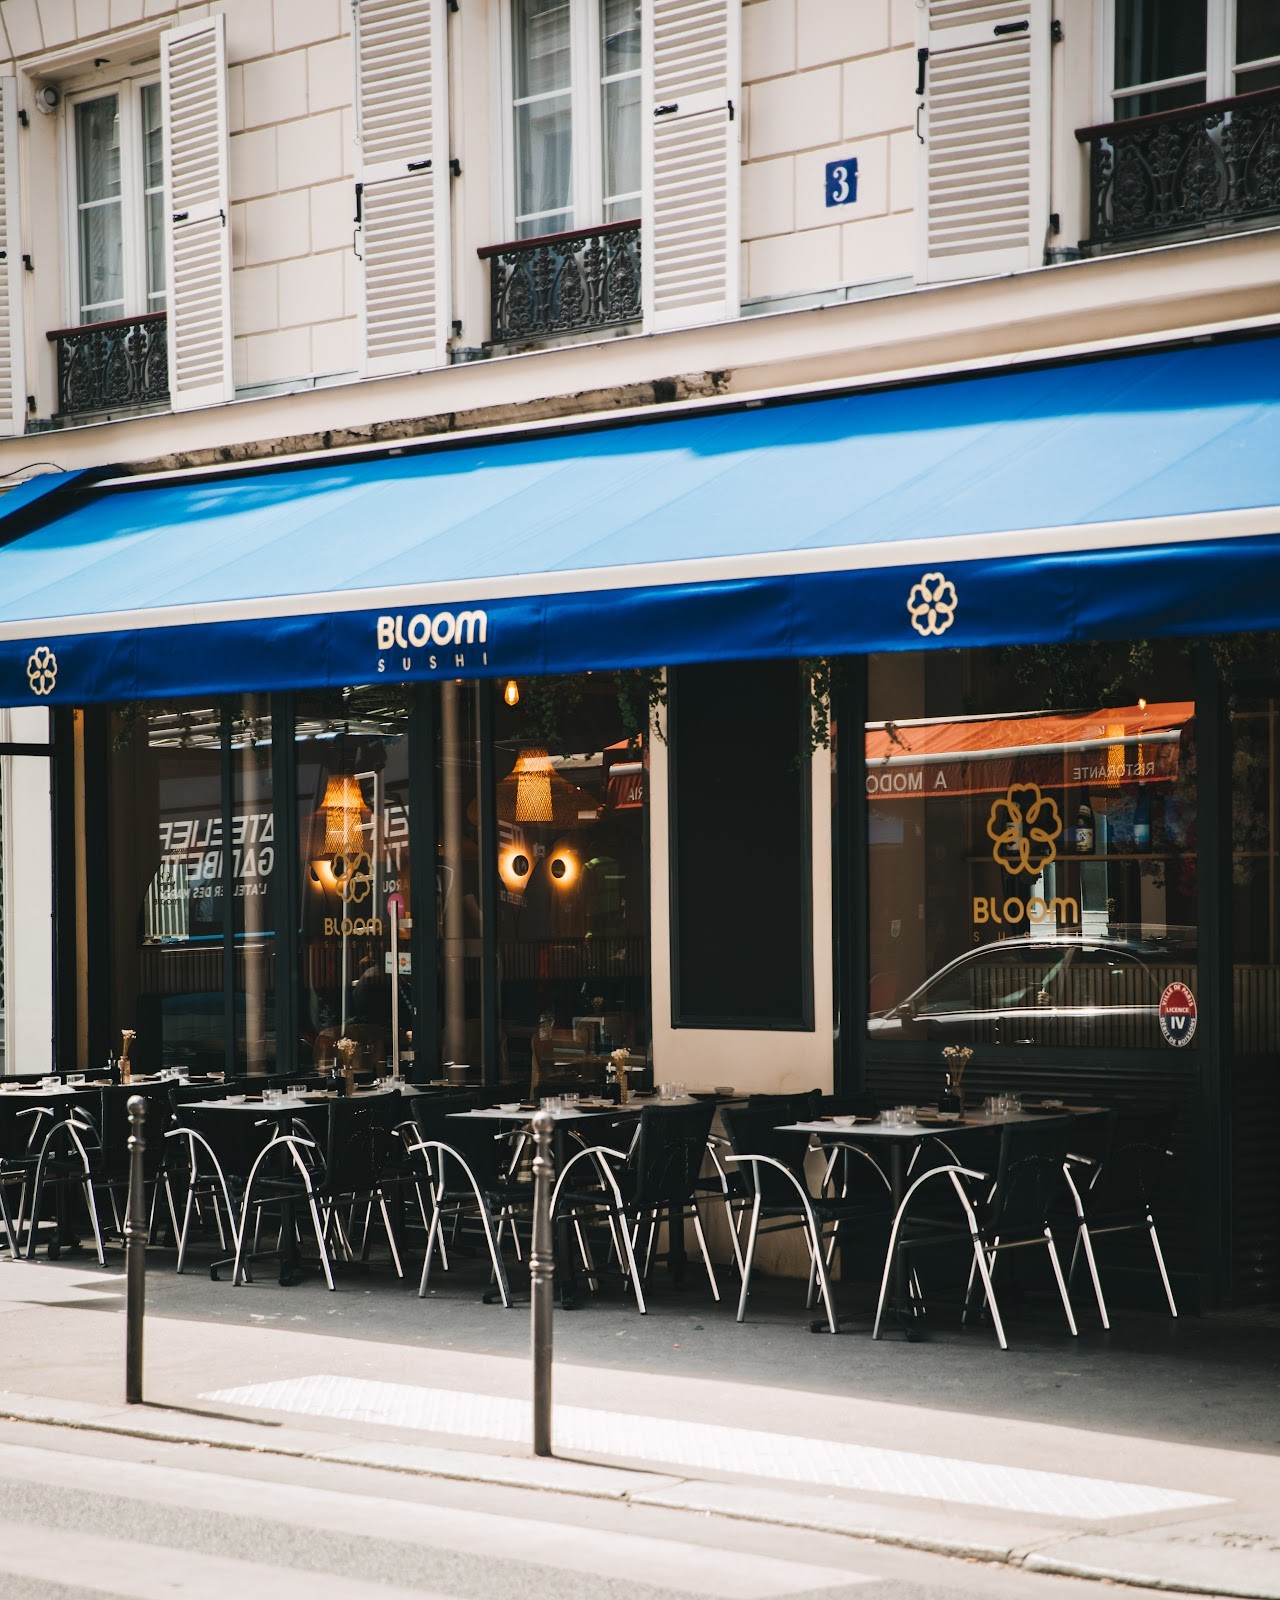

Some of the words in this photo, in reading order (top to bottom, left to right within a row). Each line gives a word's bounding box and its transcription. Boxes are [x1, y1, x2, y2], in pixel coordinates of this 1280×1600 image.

[832, 166, 850, 203] 3
[377, 609, 488, 650] BLOOM
[377, 652, 488, 673] SUSHI
[973, 896, 1079, 924] BLOOM
[324, 917, 383, 936] BLOOM
[1162, 987, 1173, 1006] VILLE
[1182, 987, 1194, 1006] PARIS
[1169, 1036, 1177, 1045] DE
[1178, 1018, 1195, 1045] BOISSONS
[1171, 1016, 1185, 1029] IV
